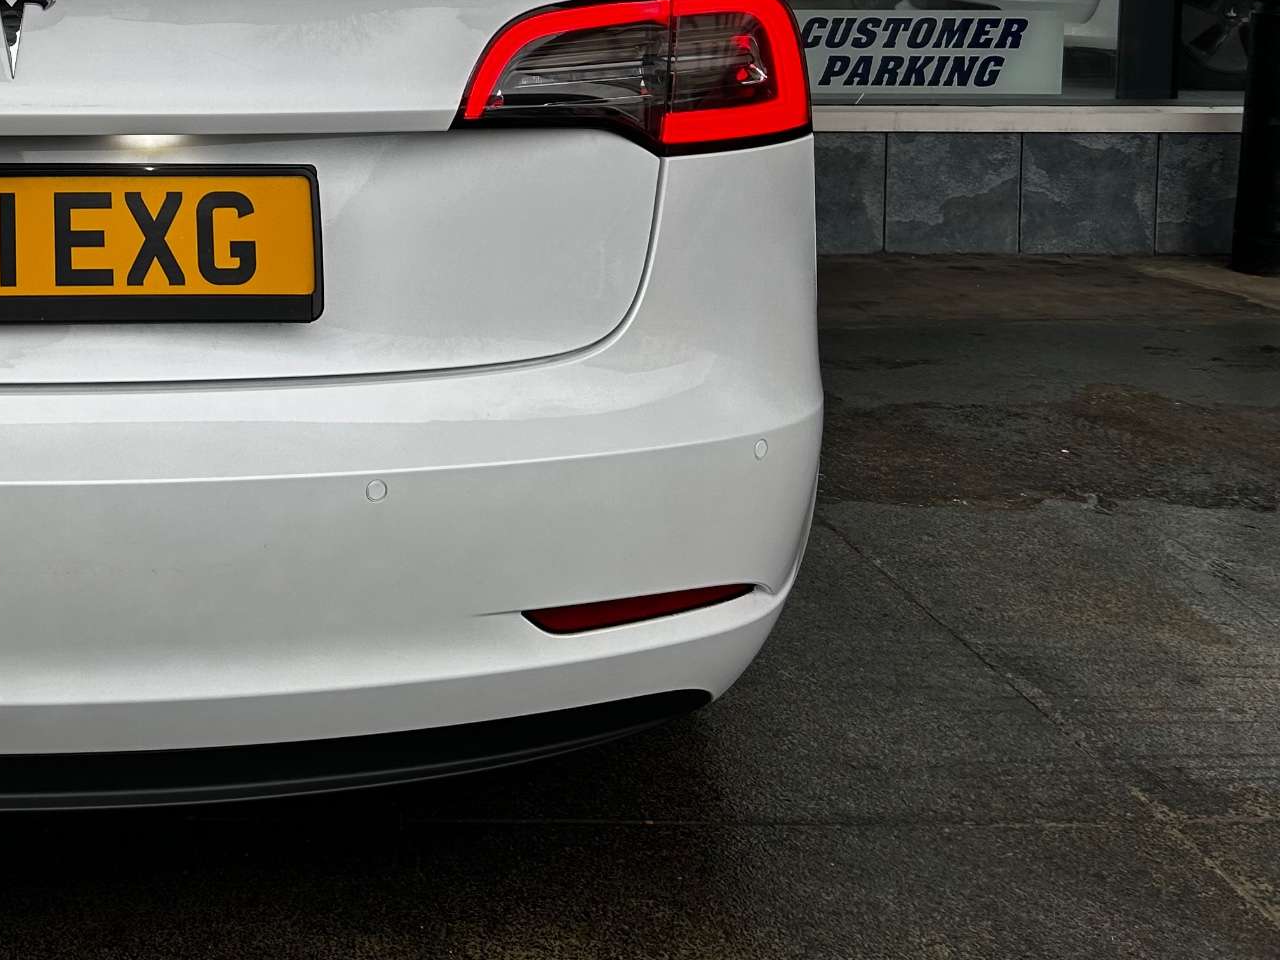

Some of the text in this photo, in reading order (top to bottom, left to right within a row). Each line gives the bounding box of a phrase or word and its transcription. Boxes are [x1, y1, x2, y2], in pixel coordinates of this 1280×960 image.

[801, 16, 1029, 50] CUSTOMER
[817, 54, 1006, 88] PARKING
[53, 191, 257, 288] EXG
